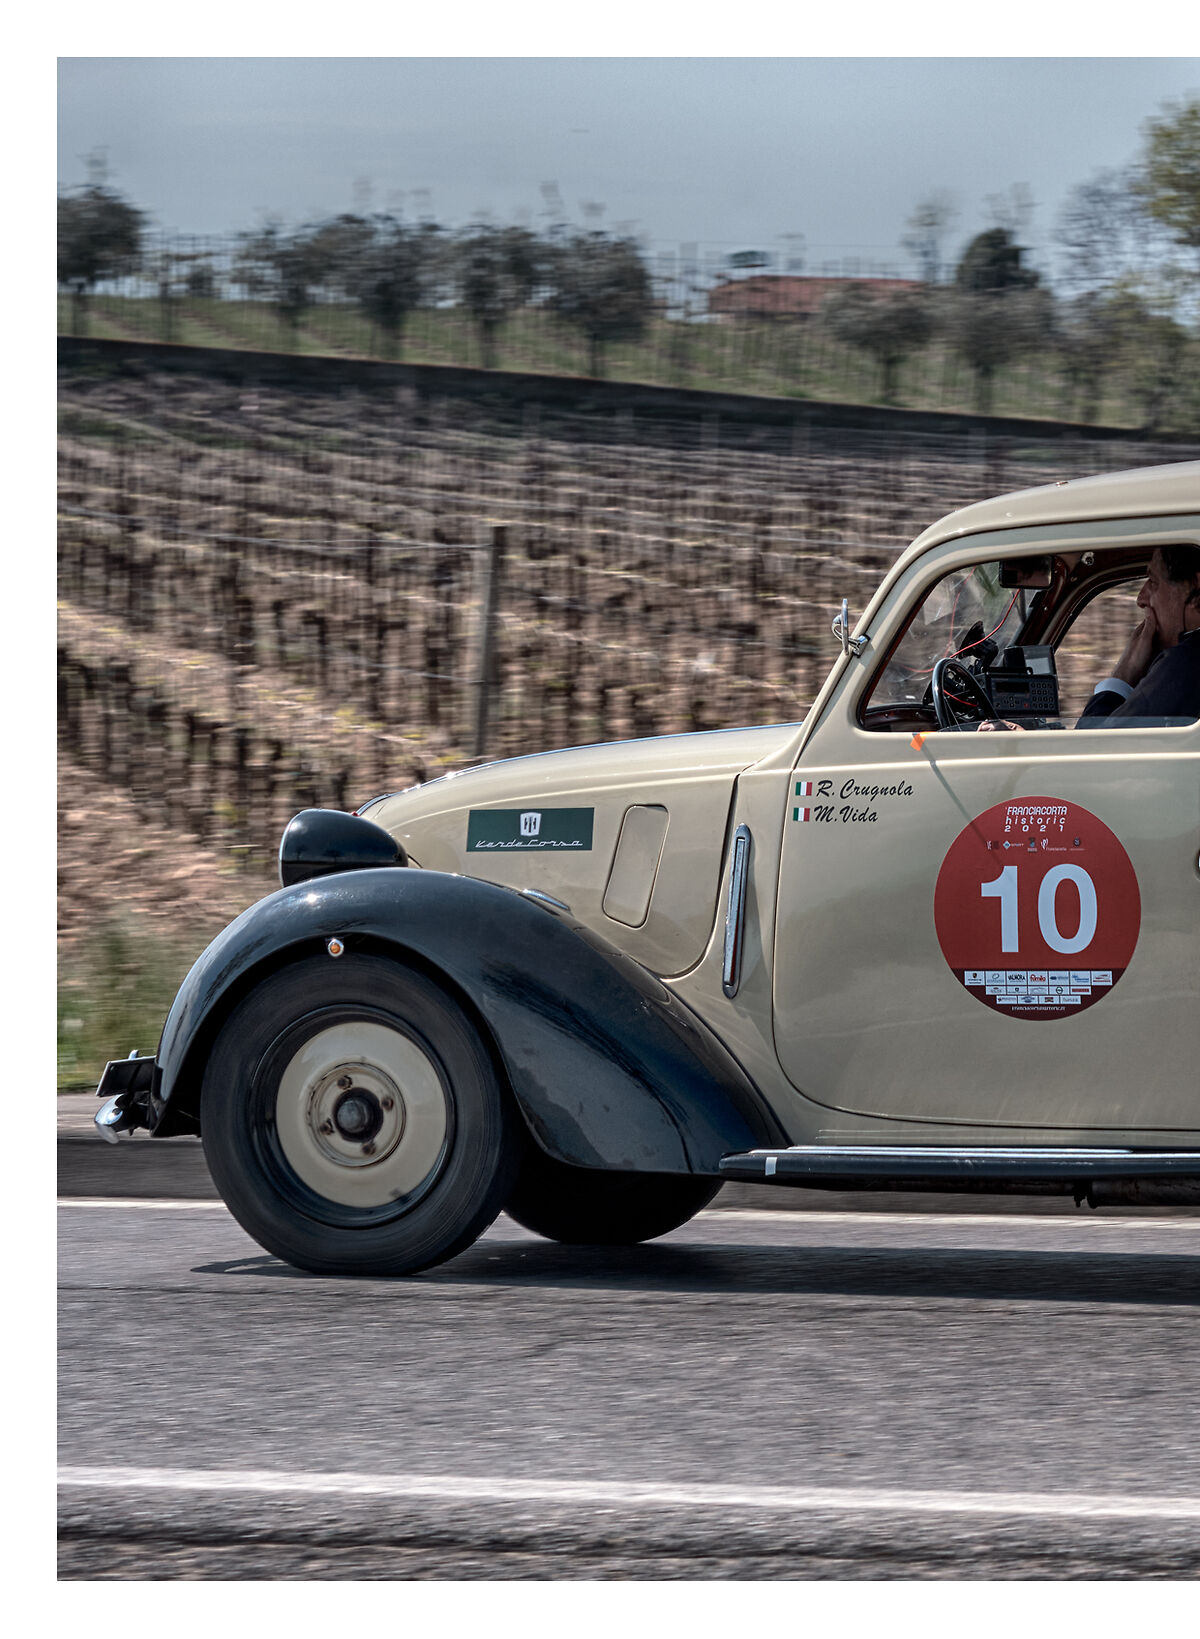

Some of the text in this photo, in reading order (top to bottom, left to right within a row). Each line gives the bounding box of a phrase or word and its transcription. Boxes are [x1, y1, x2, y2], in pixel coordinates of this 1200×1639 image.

[816, 778, 914, 801] R. Crugnola
[1006, 806, 1068, 815] FRANCIACORTA
[1005, 816, 1066, 825] historic
[981, 863, 1098, 955] 10
